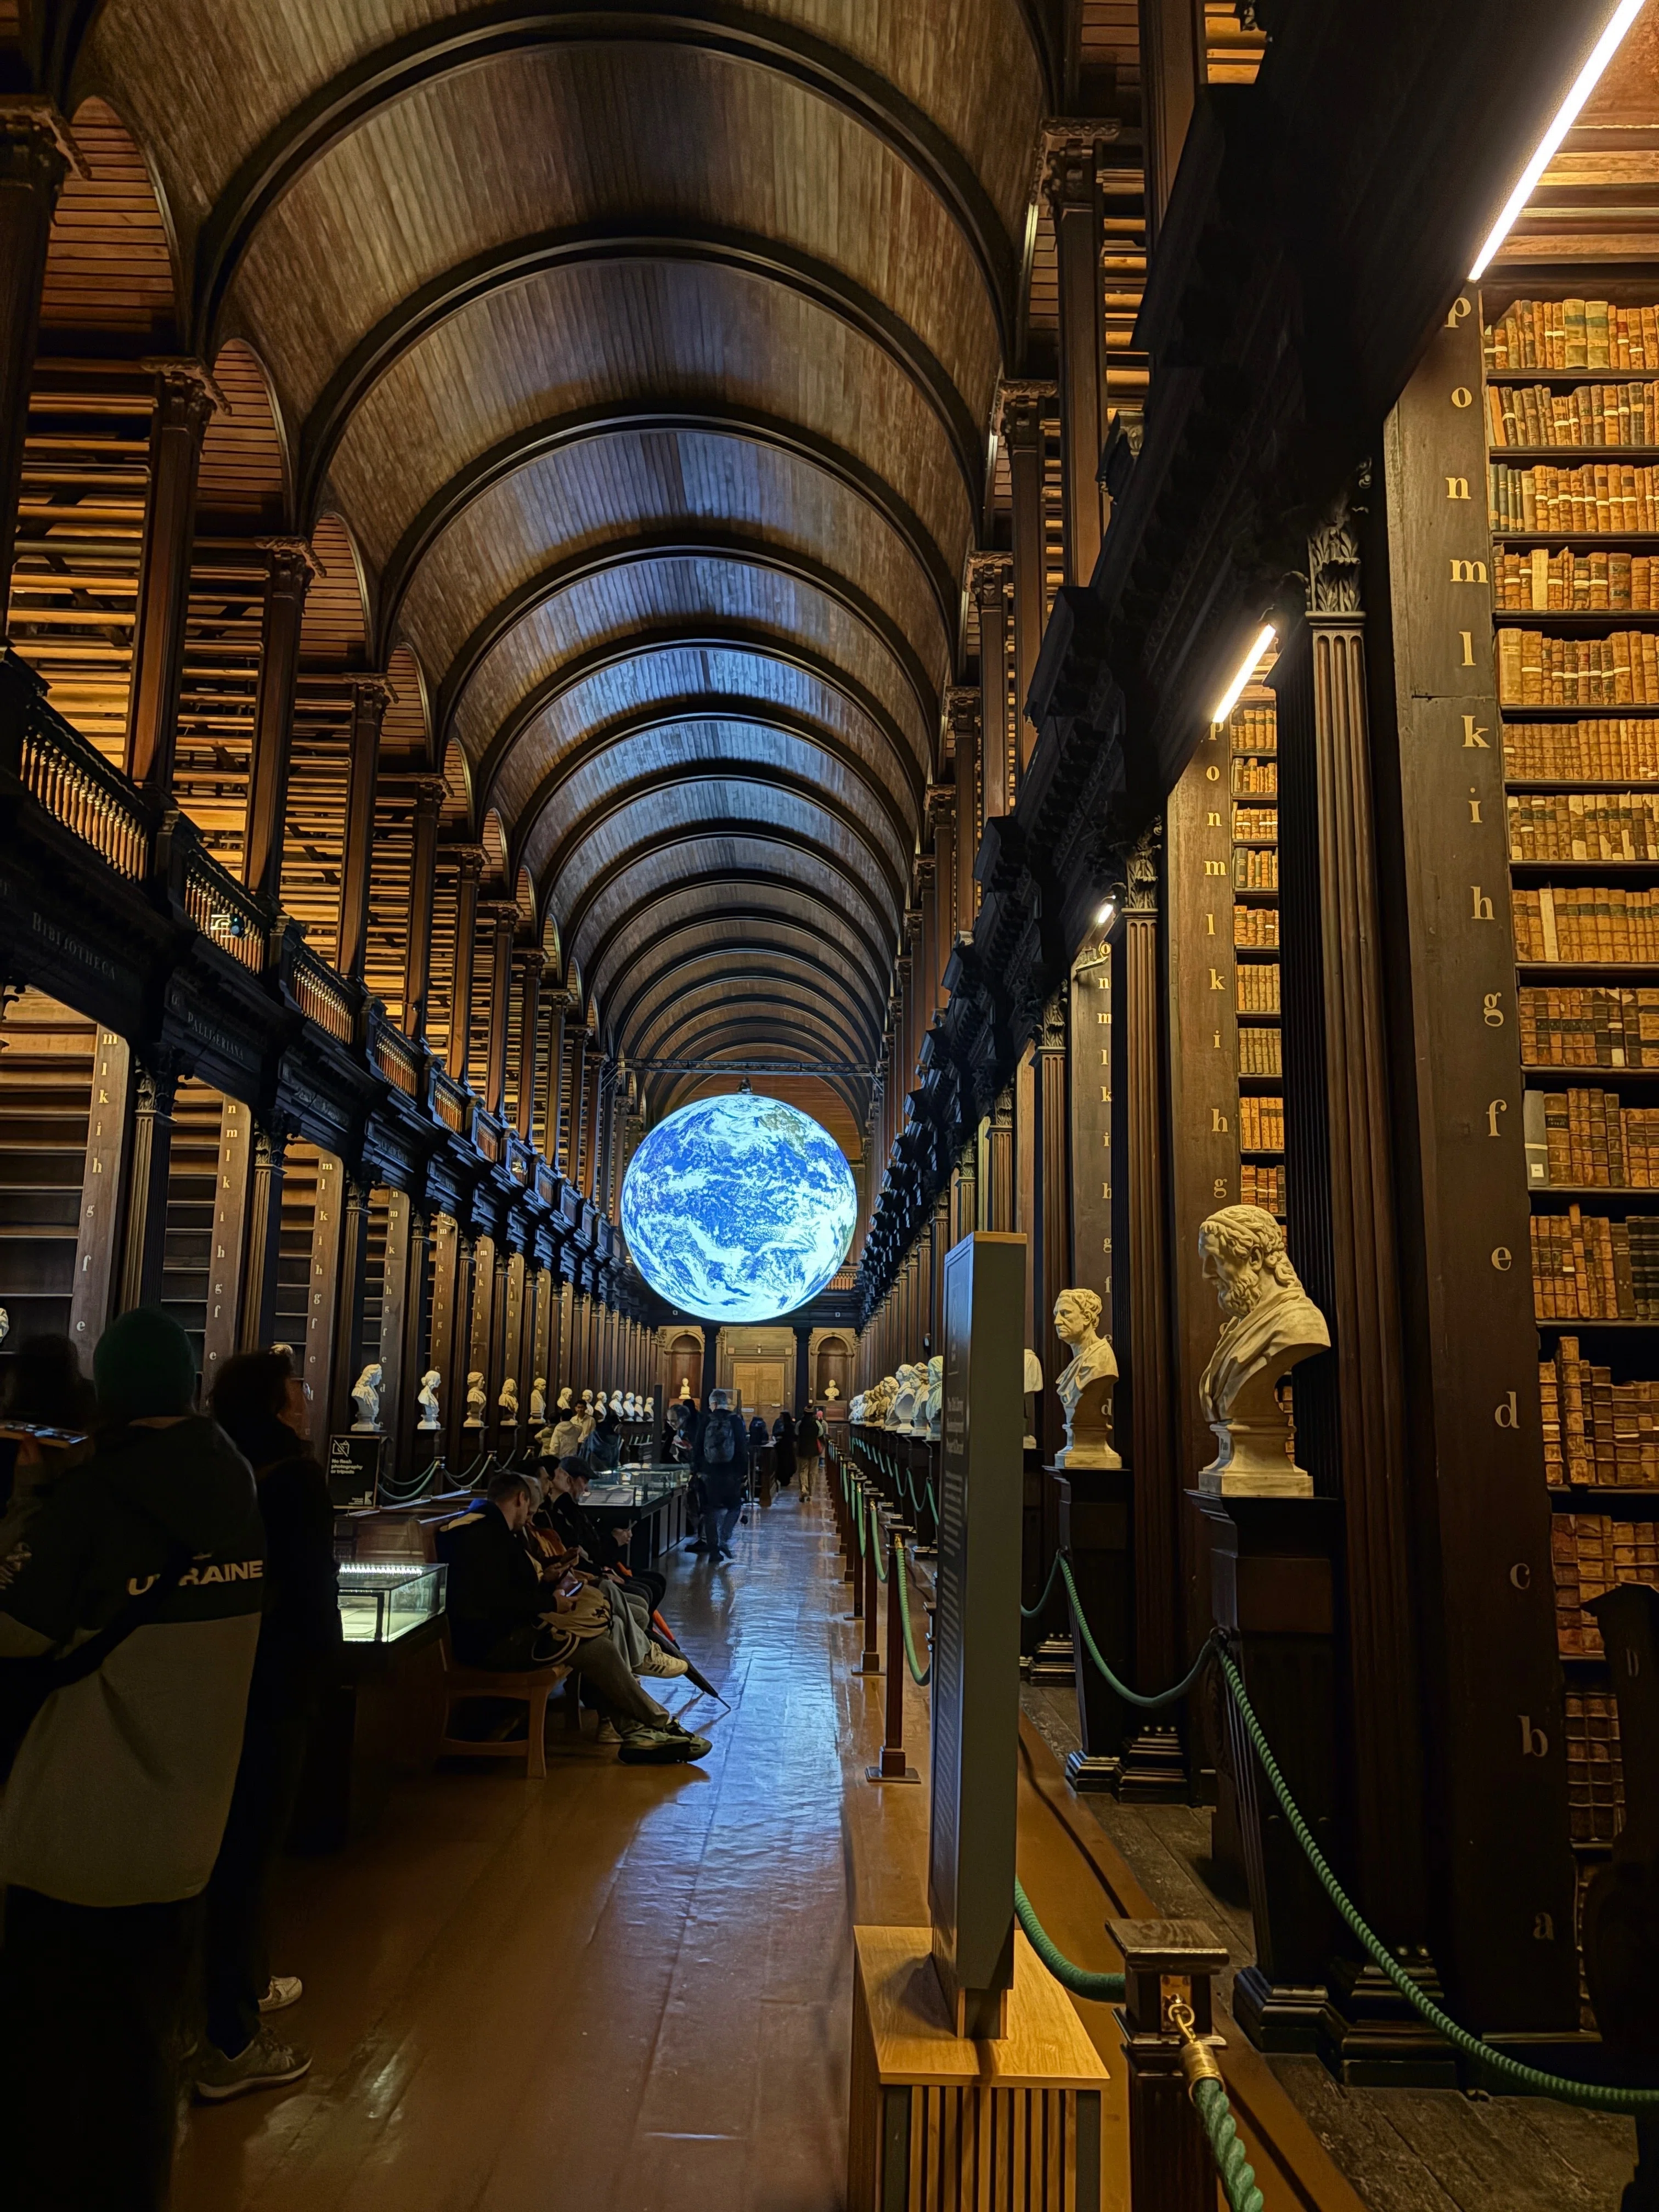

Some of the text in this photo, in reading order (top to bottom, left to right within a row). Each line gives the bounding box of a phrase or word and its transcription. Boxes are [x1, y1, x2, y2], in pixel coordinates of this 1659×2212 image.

[32, 911, 116, 981] BIBLIOTHECA
[1101, 944, 1111, 955] o
[1204, 722, 1228, 1198] p o n m l k i h g
[1098, 978, 1110, 989] n
[1097, 1013, 1111, 1024] m
[1101, 1049, 1108, 1065] l
[1101, 1086, 1111, 1102] k
[1444, 297, 1554, 1940] p o n m l k i h g f e d c b a
[1103, 1132, 1110, 1146] i
[226, 1149, 230, 1161] l
[77, 1034, 117, 1331] m l k i h g f e
[223, 1176, 229, 1188] k
[321, 1179, 325, 1189] l
[220, 1211, 224, 1221] i
[320, 1211, 328, 1220] k
[390, 1222, 393, 1230] l
[318, 1236, 321, 1245] i
[1103, 1238, 1111, 1252] g
[217, 1245, 224, 1257] h
[315, 1265, 322, 1274] h
[387, 1267, 390, 1275] i
[215, 1284, 222, 1294] g
[386, 1285, 392, 1294] h
[439, 1284, 442, 1293] i
[1105, 1276, 1111, 1293] f
[314, 1294, 321, 1304] g
[215, 1305, 221, 1317] f
[312, 1318, 317, 1329] f
[436, 1339, 440, 1347] f
[380, 1384, 385, 1392] d
[1101, 1398, 1113, 1415] d
[127, 1560, 263, 1596] URAINE
